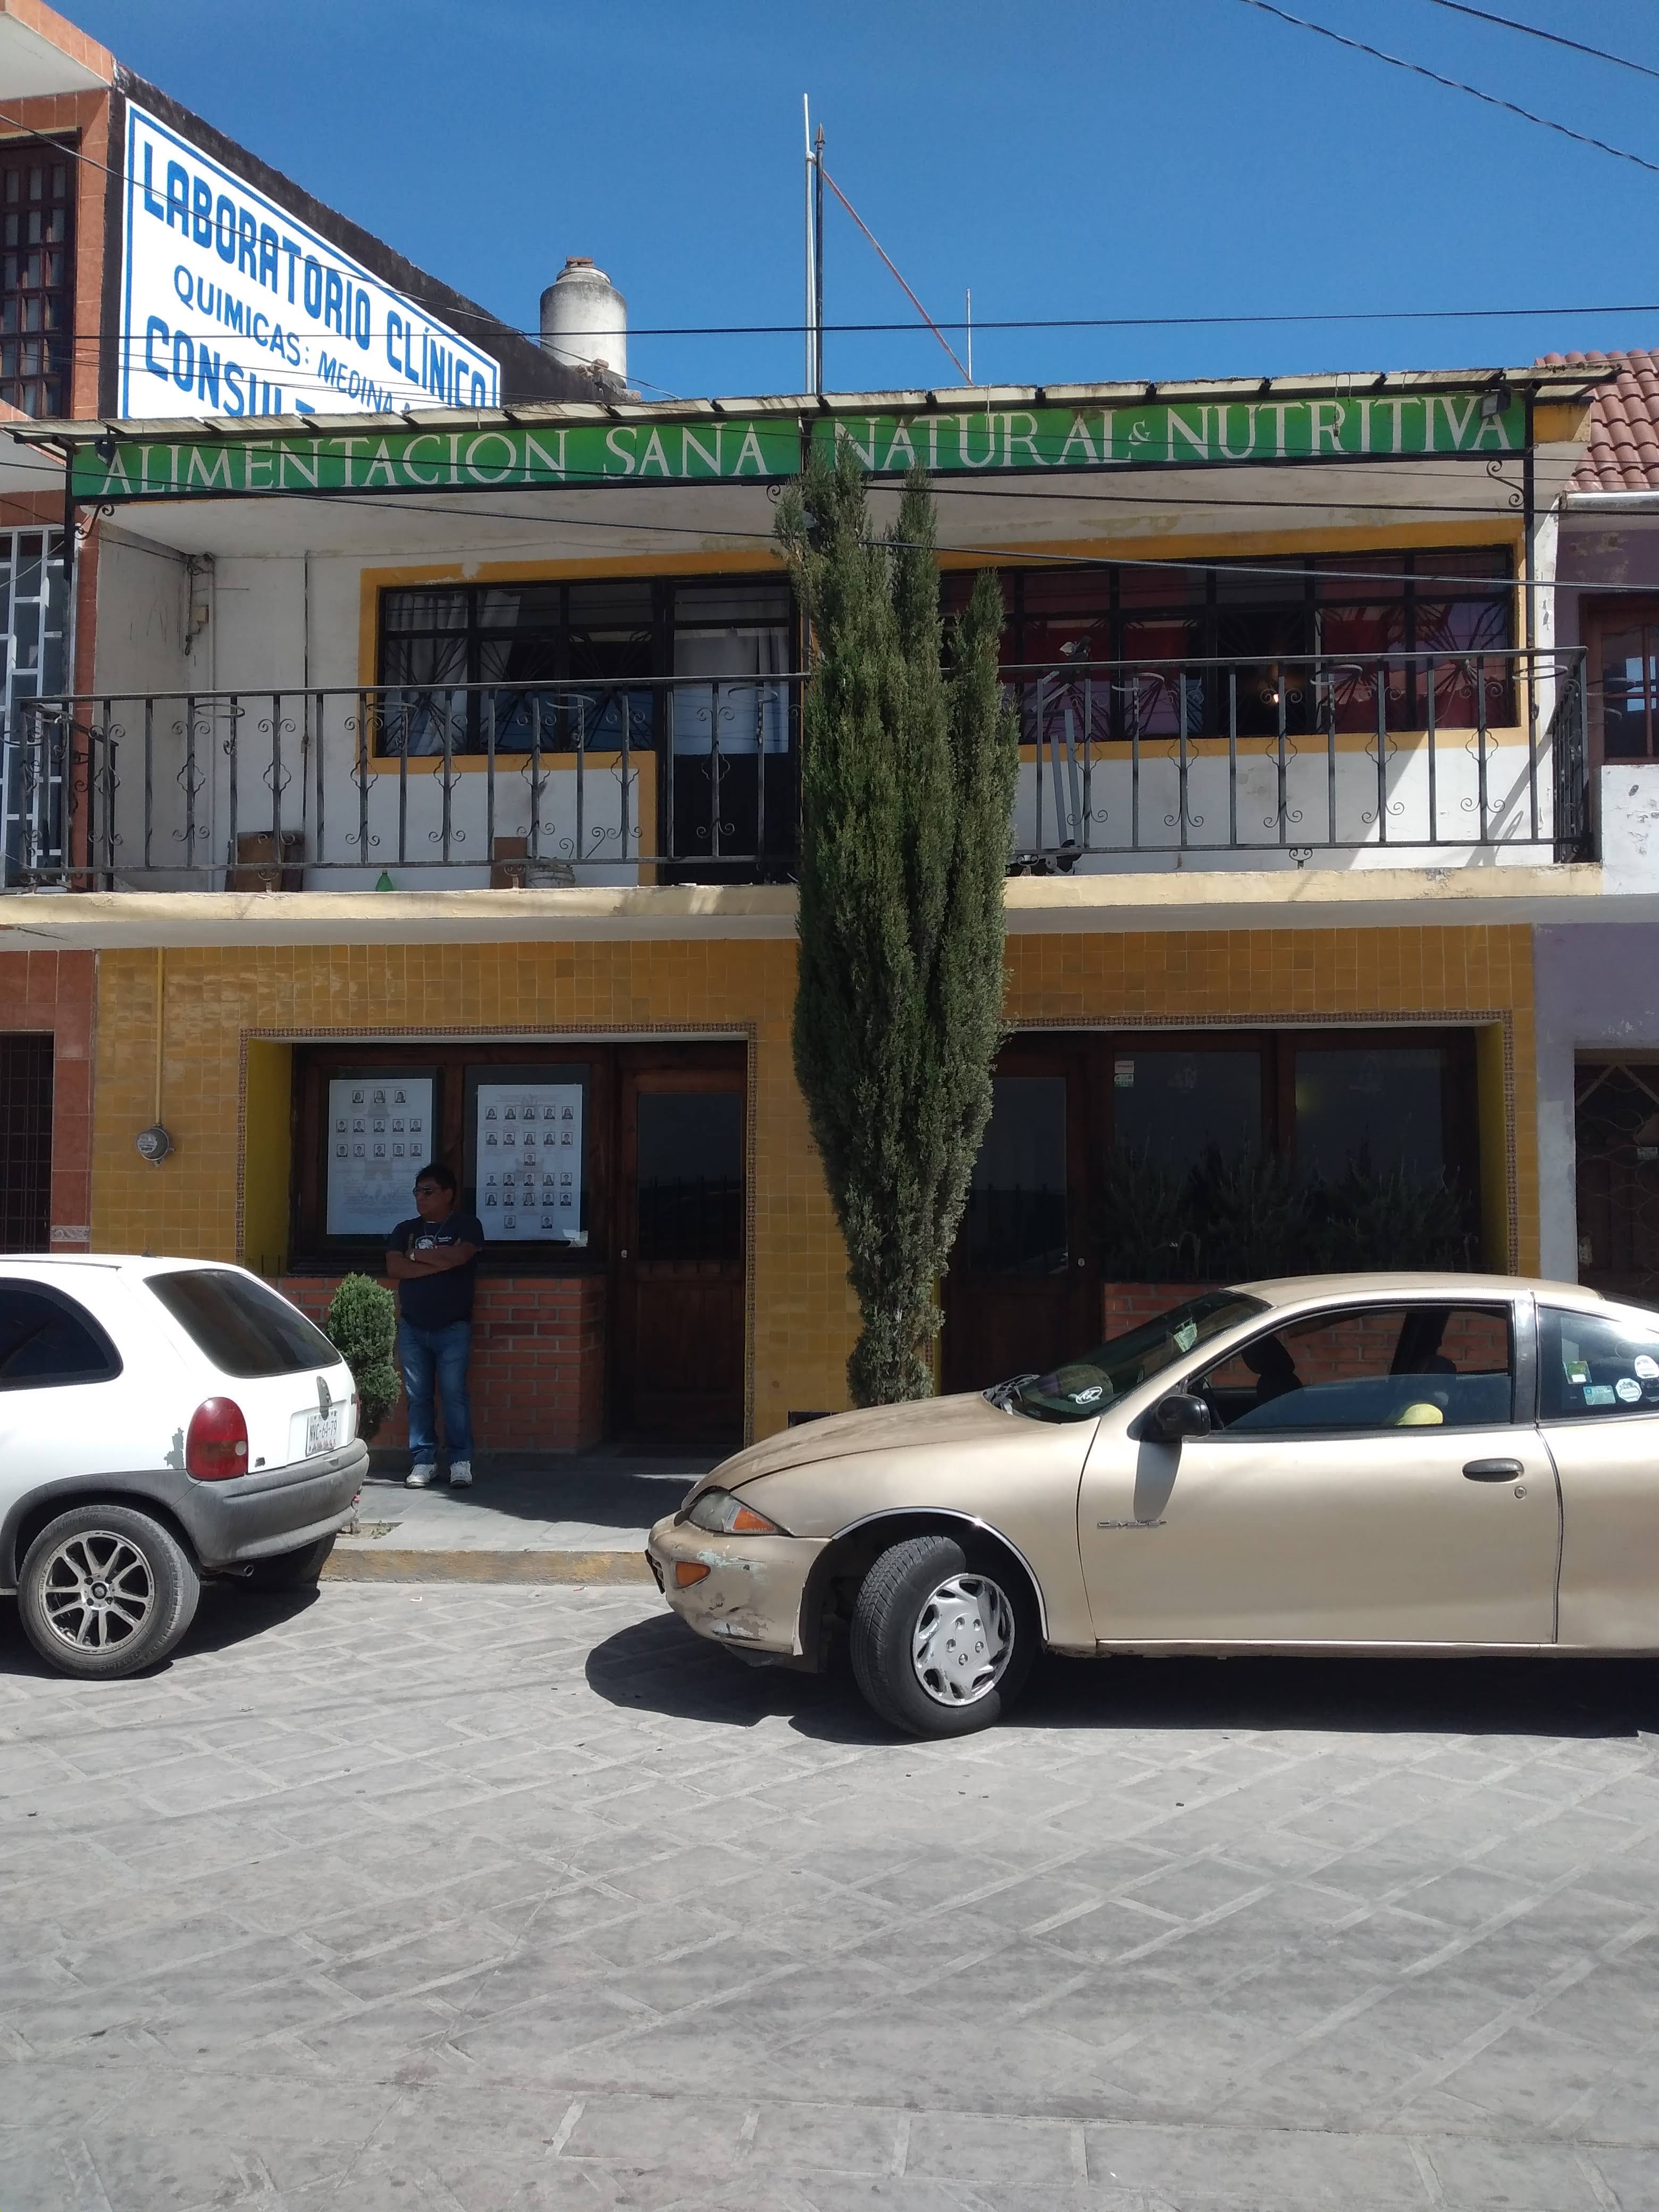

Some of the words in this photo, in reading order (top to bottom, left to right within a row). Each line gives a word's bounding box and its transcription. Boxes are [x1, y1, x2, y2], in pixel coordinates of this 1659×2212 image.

[144, 141, 371, 350] LABORATORIO
[386, 309, 485, 408] CLÍNICO
[173, 265, 310, 366] QUIMICAS:
[318, 350, 392, 412] MEDINA
[100, 429, 569, 495] ALIMENTACION
[603, 422, 773, 480] SANA
[834, 408, 1132, 471] NATURAL
[1128, 420, 1151, 445] &
[1167, 396, 1513, 462] NUTRITIVA
